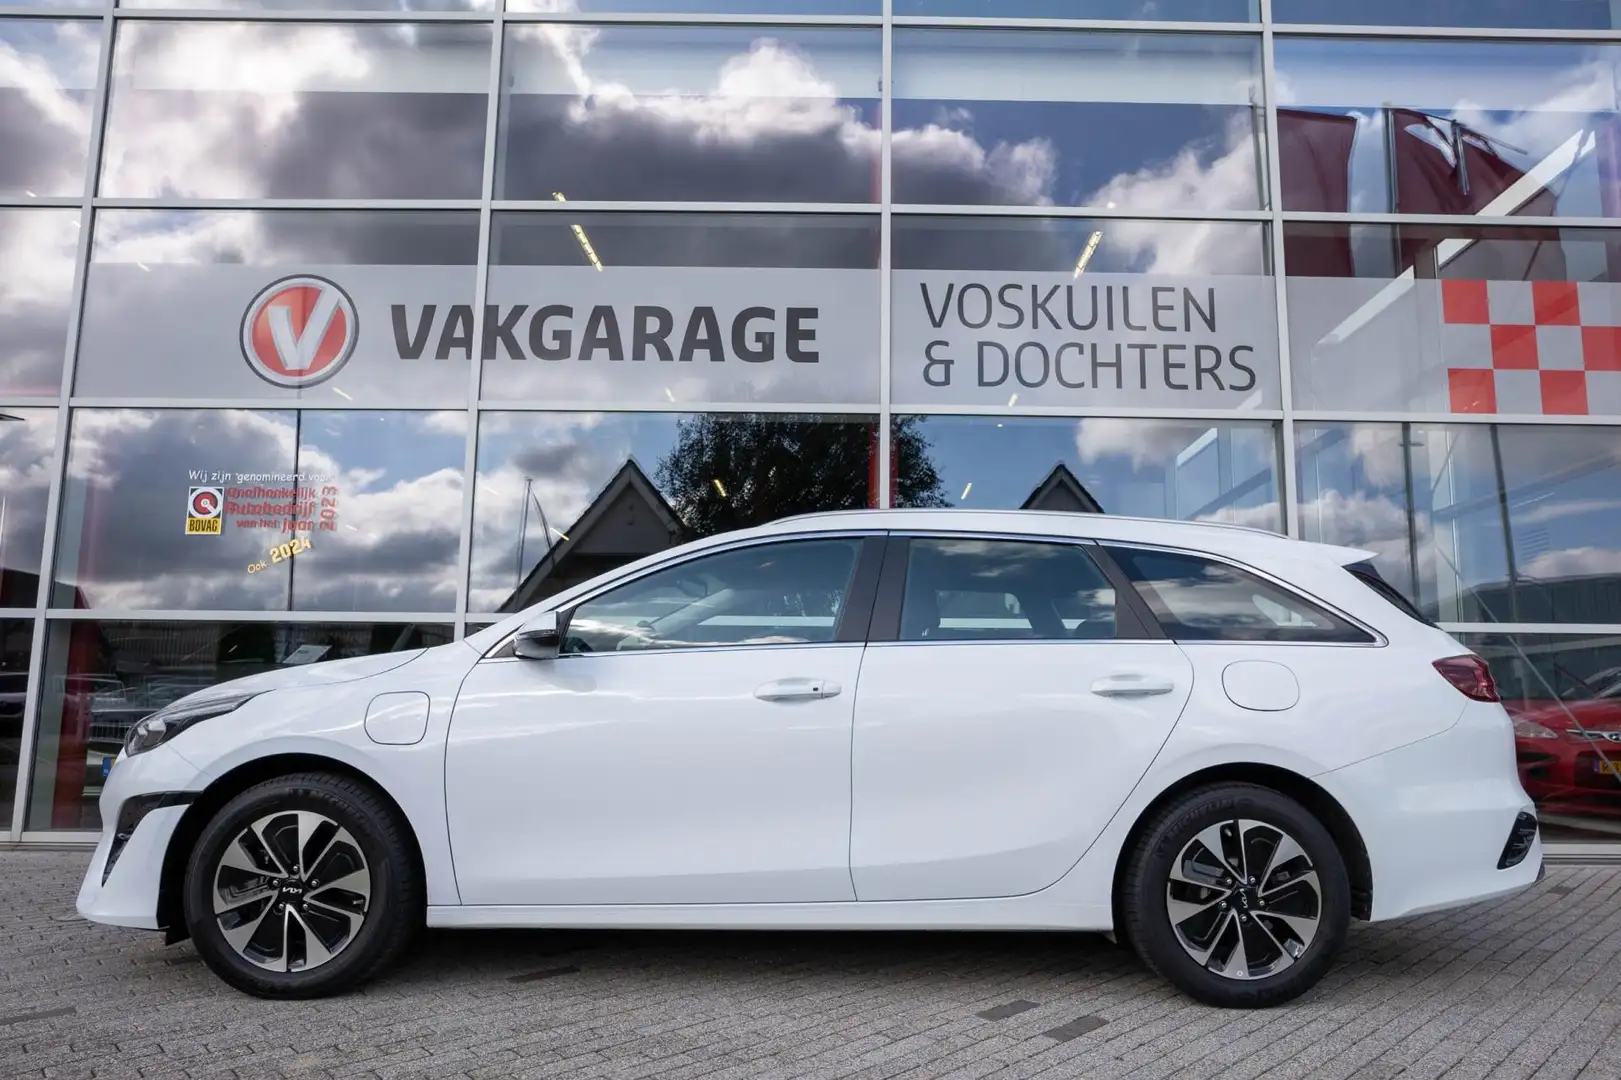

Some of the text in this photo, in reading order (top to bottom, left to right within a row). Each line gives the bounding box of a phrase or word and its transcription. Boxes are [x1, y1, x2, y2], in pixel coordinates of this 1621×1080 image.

[919, 282, 1217, 333] VOSKUILEN
[390, 303, 820, 364] VAKGARAGE
[922, 340, 1257, 392] & DOCHTERS
[188, 469, 208, 483] Wij
[210, 470, 232, 483] zijn
[189, 518, 219, 532] BOVAG
[247, 536, 312, 574] Ook 2024
